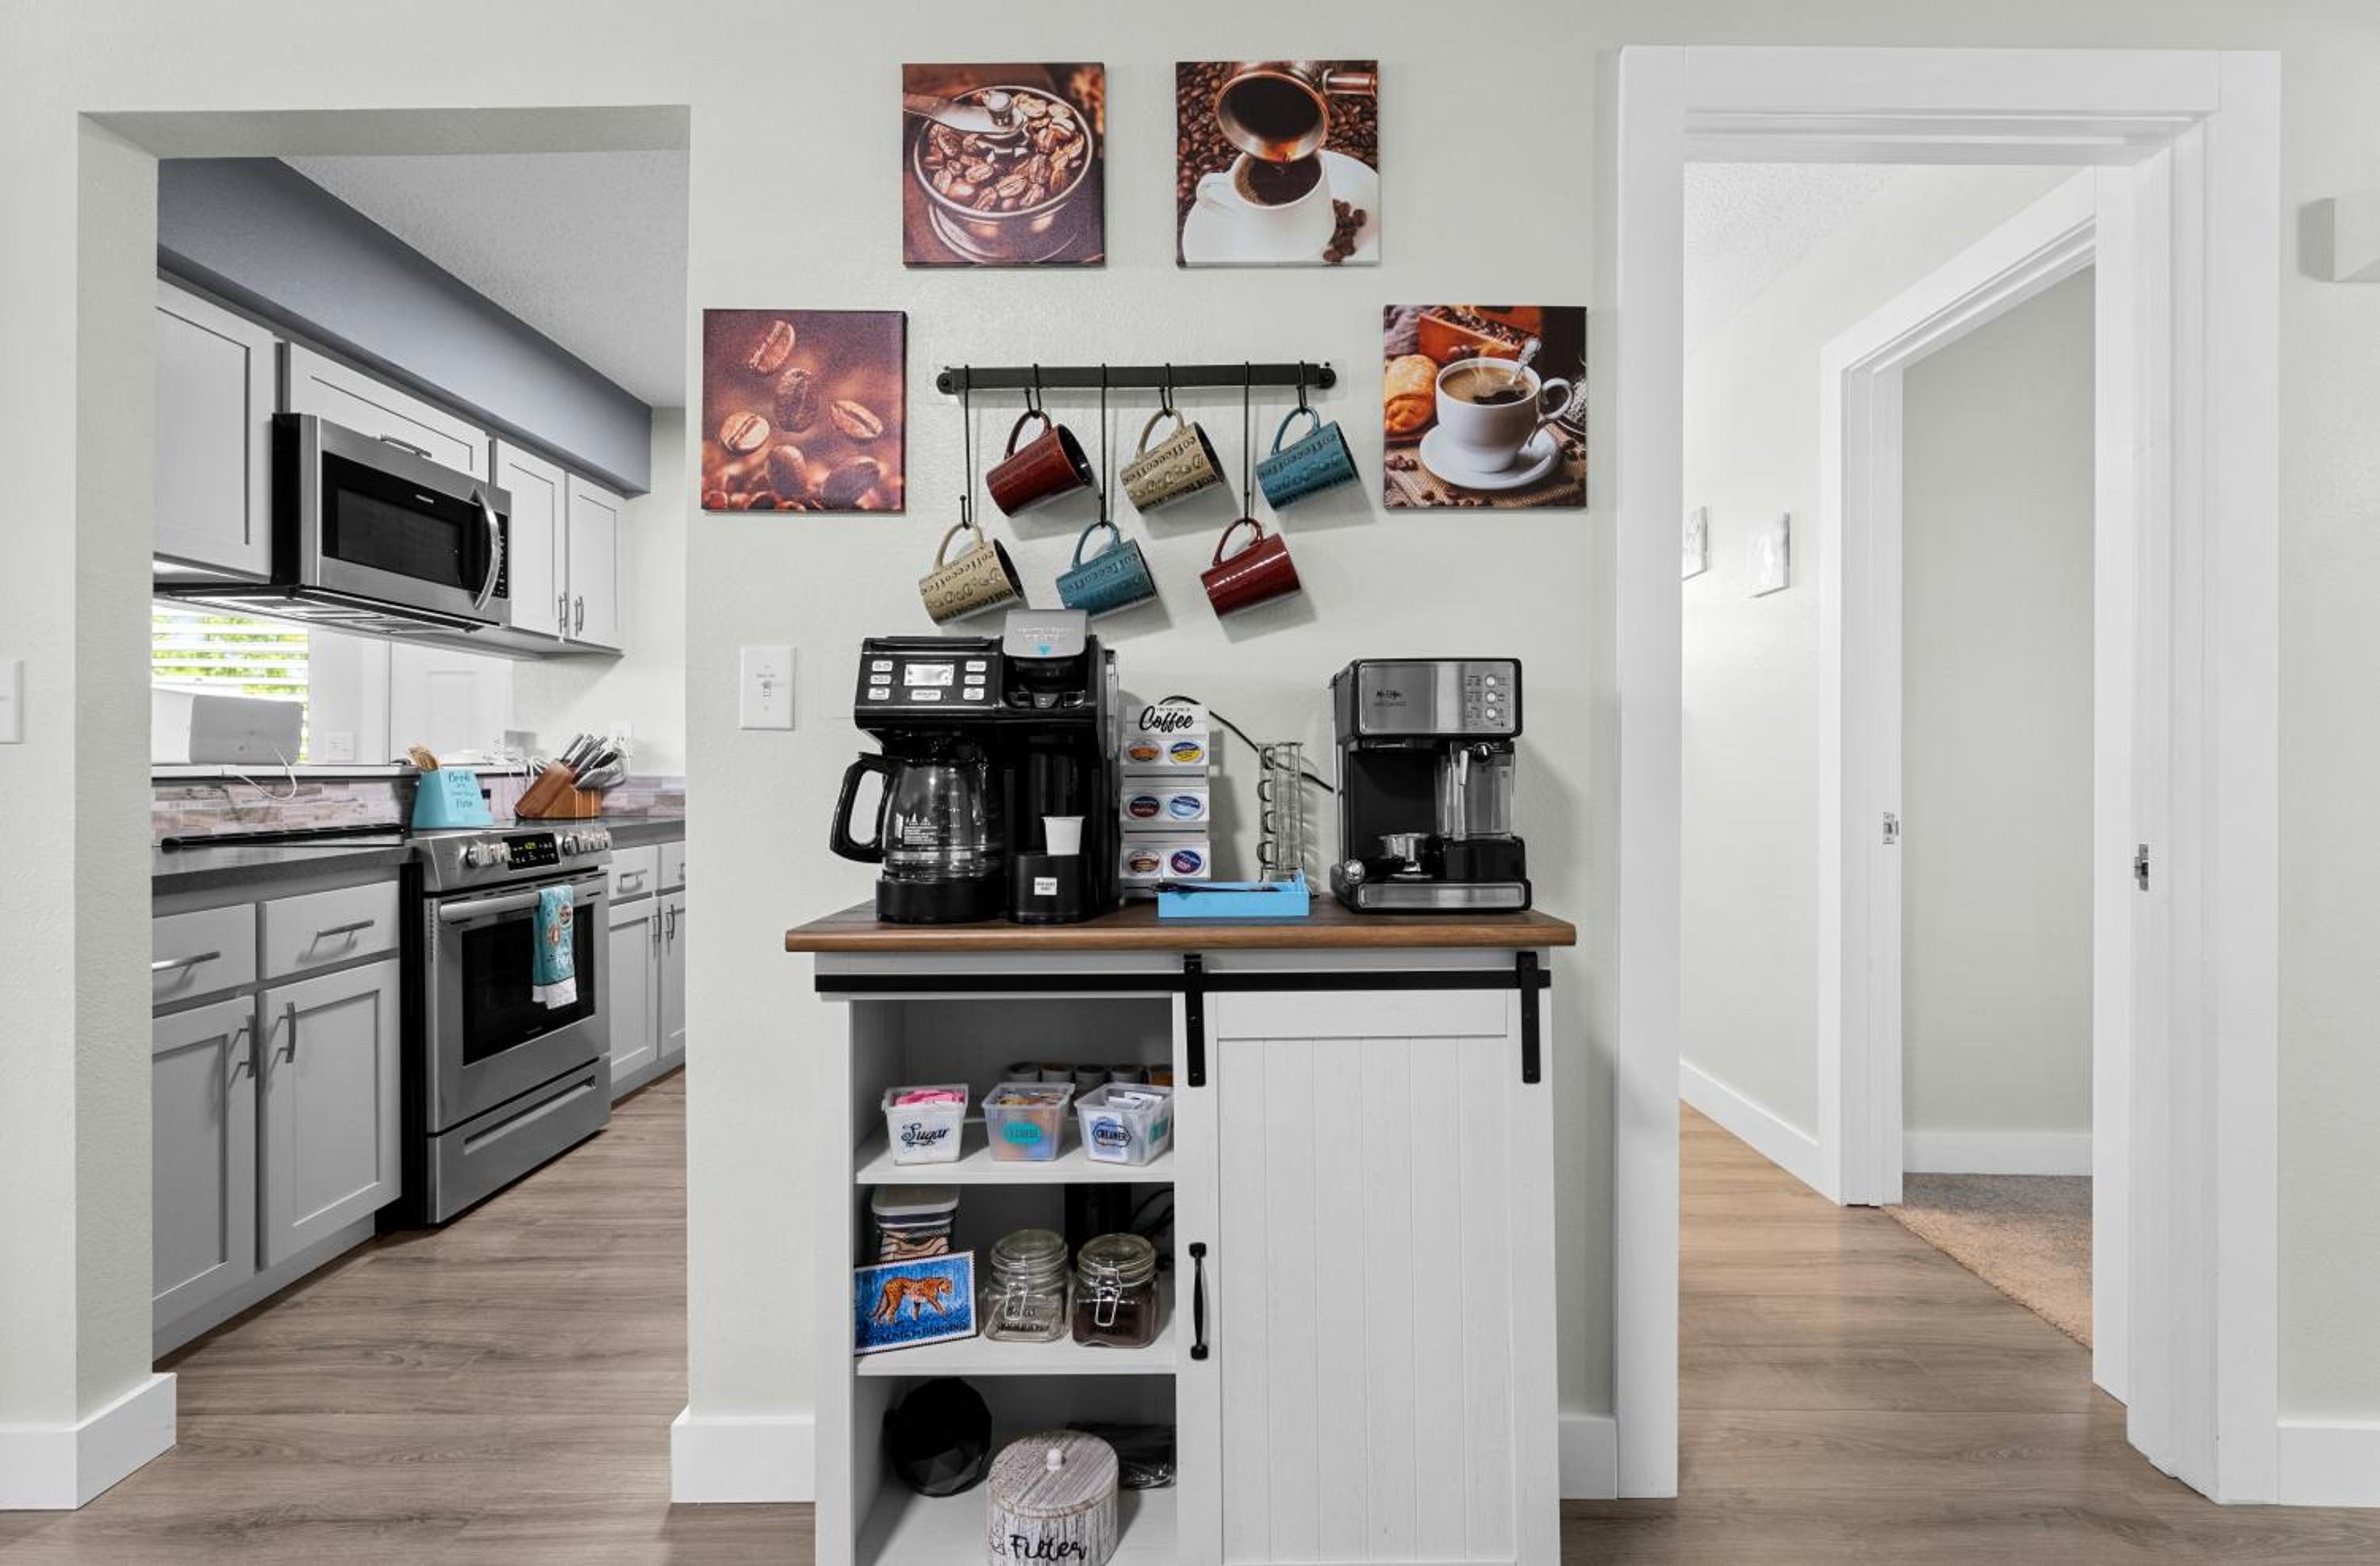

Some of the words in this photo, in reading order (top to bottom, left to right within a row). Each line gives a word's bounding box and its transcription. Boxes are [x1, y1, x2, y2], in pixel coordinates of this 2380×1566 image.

[1138, 704, 1194, 734] Coffee
[900, 1123, 950, 1148] Sugar
[1096, 1128, 1128, 1142] CREAMER
[1008, 1533, 1088, 1562] Filter
